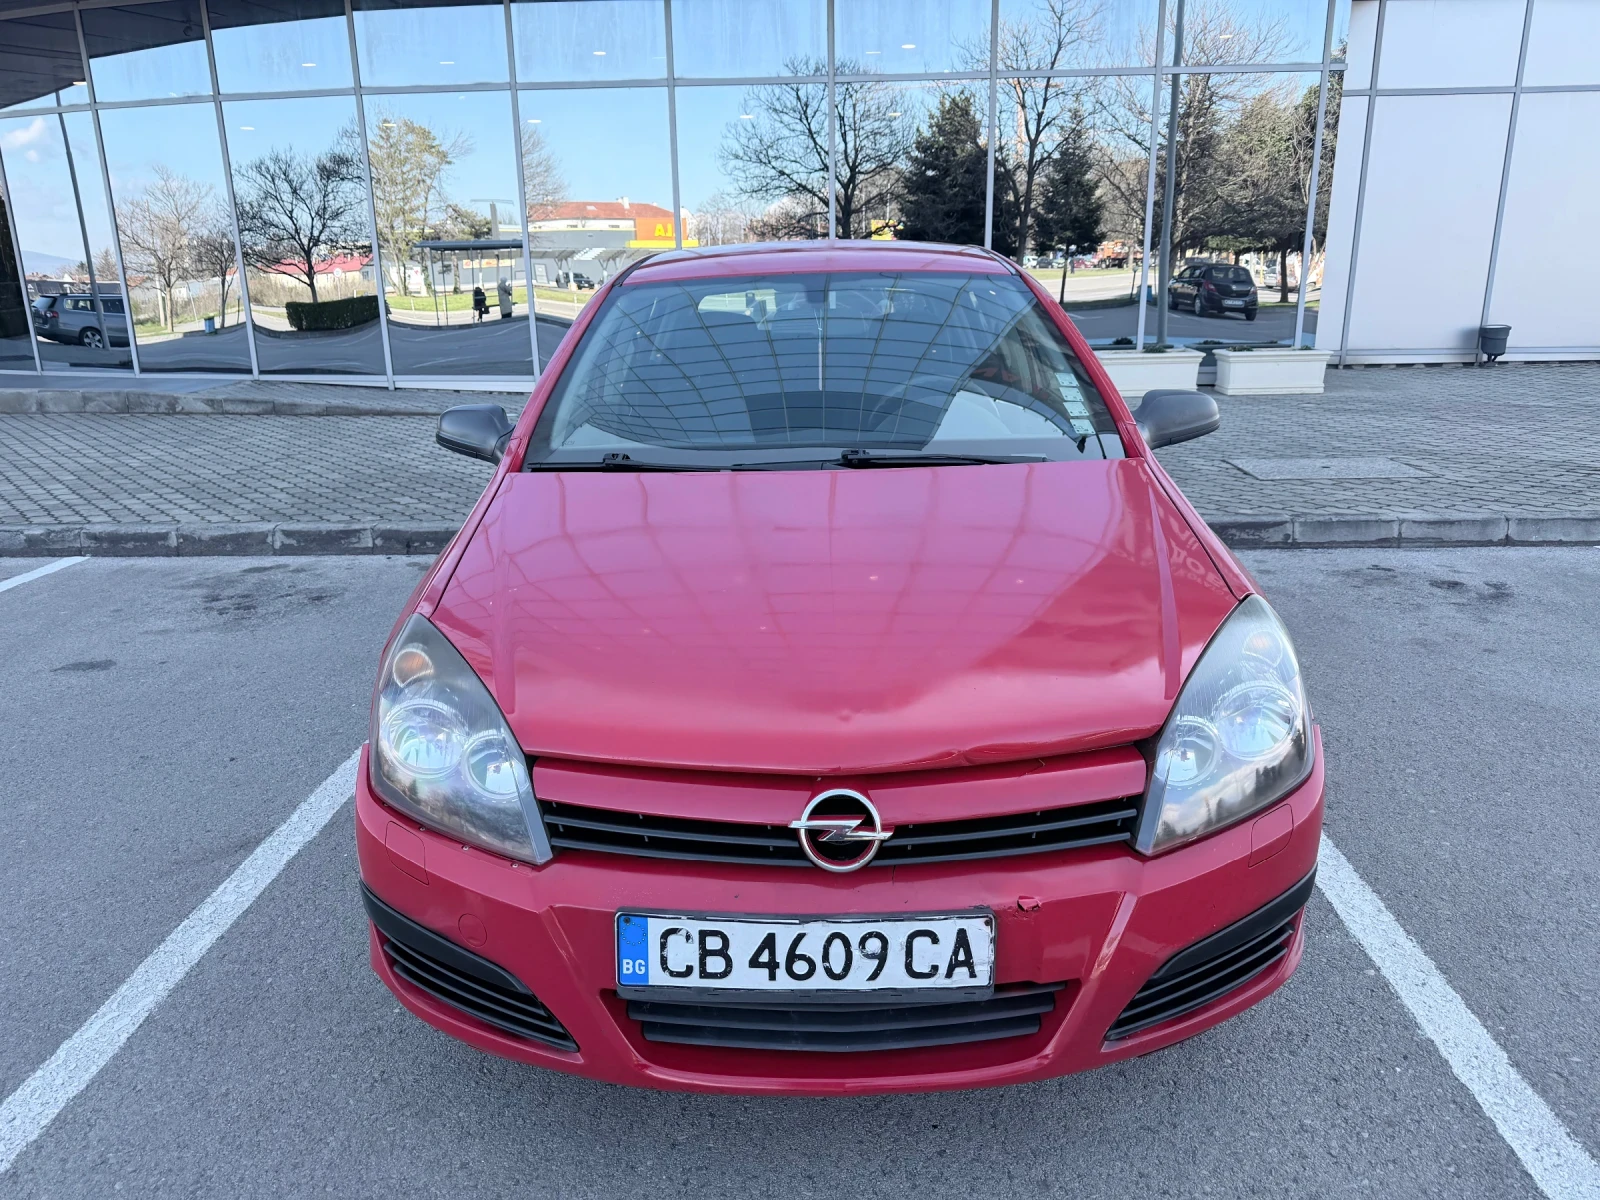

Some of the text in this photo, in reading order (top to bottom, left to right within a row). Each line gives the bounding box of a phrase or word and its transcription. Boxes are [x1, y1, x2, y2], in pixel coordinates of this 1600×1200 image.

[622, 959, 646, 976] BG
[659, 927, 978, 982] CB 4609 CA
